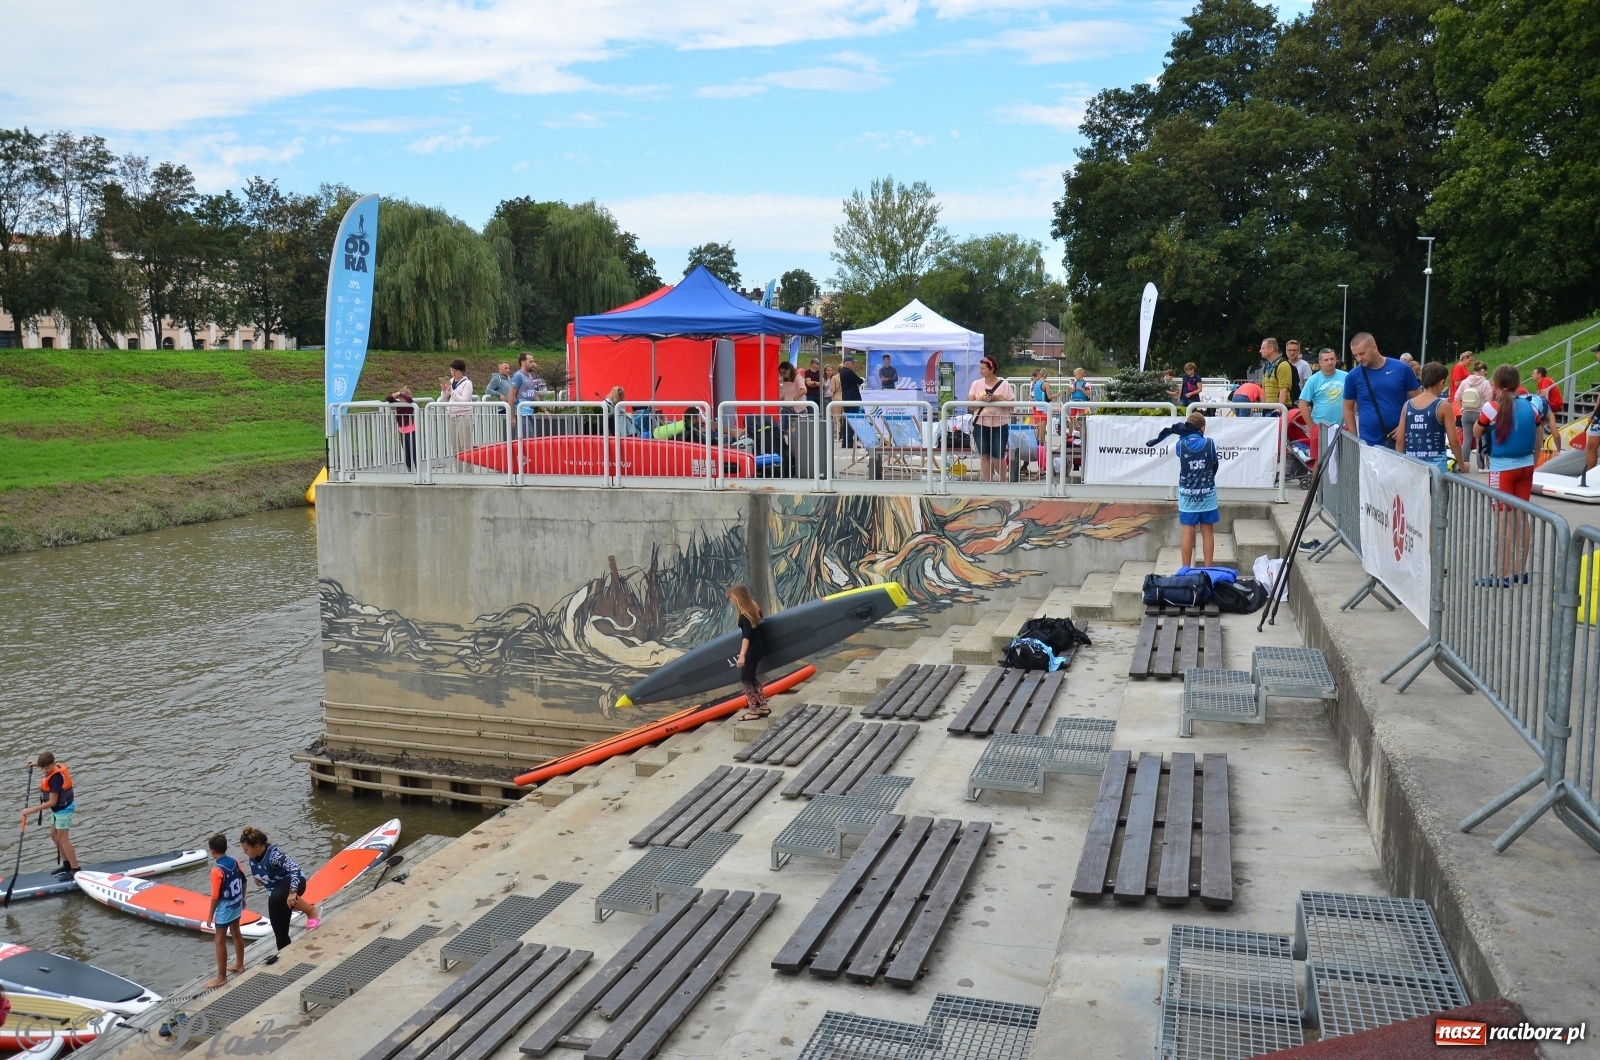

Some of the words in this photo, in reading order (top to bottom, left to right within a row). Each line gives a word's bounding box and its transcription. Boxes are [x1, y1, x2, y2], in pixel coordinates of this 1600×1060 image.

[1098, 445, 1169, 458] www.zwsup.pl
[1216, 451, 1239, 460] SUP
[1188, 459, 1206, 470] 135
